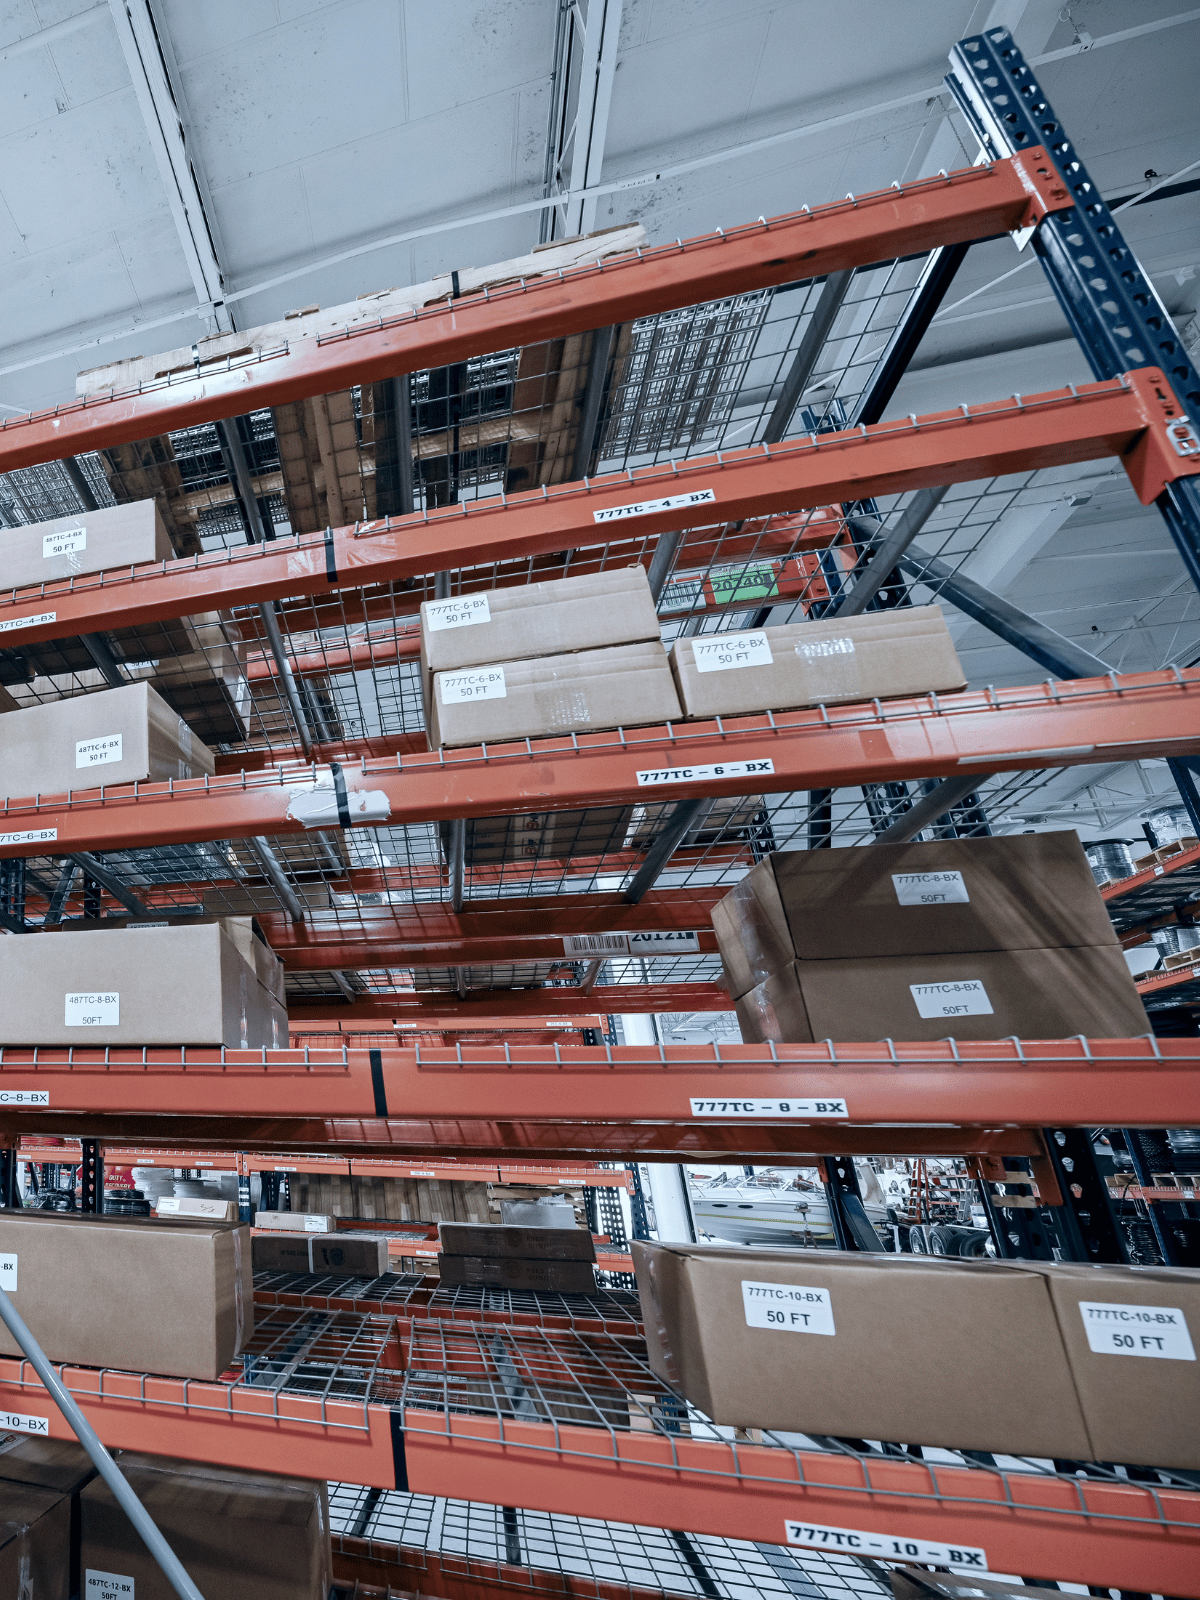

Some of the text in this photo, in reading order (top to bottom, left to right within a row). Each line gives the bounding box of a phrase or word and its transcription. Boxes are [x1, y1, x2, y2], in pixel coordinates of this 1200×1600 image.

[596, 505, 644, 519] 777TC
[689, 491, 712, 502] BX
[45, 530, 83, 543] 487TC-4-BX
[64, 542, 75, 550] FT
[430, 599, 486, 615] 777TC-6-BX
[446, 612, 472, 623] 50 FT
[698, 638, 766, 654] 777TC-6-BX
[718, 651, 750, 664] 50 FT
[444, 673, 502, 688] 777TC-6-BX
[460, 685, 488, 697] 50 FT
[78, 740, 120, 754] 487TC-6-BX
[89, 751, 109, 762] 50 FT
[639, 769, 693, 782] 777TC
[713, 766, 725, 775] 6
[745, 761, 772, 772] BX
[897, 874, 959, 884] 777TC-8-BX
[920, 893, 946, 903] 50FT
[915, 982, 980, 995] 777TC-8-BX
[68, 995, 117, 1004] 487TC-8-BX
[942, 1004, 969, 1015] 50FT
[82, 1016, 103, 1025] 50FT
[694, 1102, 755, 1112] 777TC
[778, 1102, 791, 1112] 8
[814, 1102, 845, 1113] BX
[747, 1286, 824, 1303] 777TC-10-BX
[767, 1310, 811, 1326] 50 FT
[1086, 1308, 1178, 1325] 777TC-10-BX
[1112, 1333, 1165, 1350] 50 FT
[789, 1525, 861, 1548] 777TC
[892, 1541, 919, 1556] 10
[947, 1549, 984, 1566] BX
[87, 1578, 131, 1593] 487TC-12-BX
